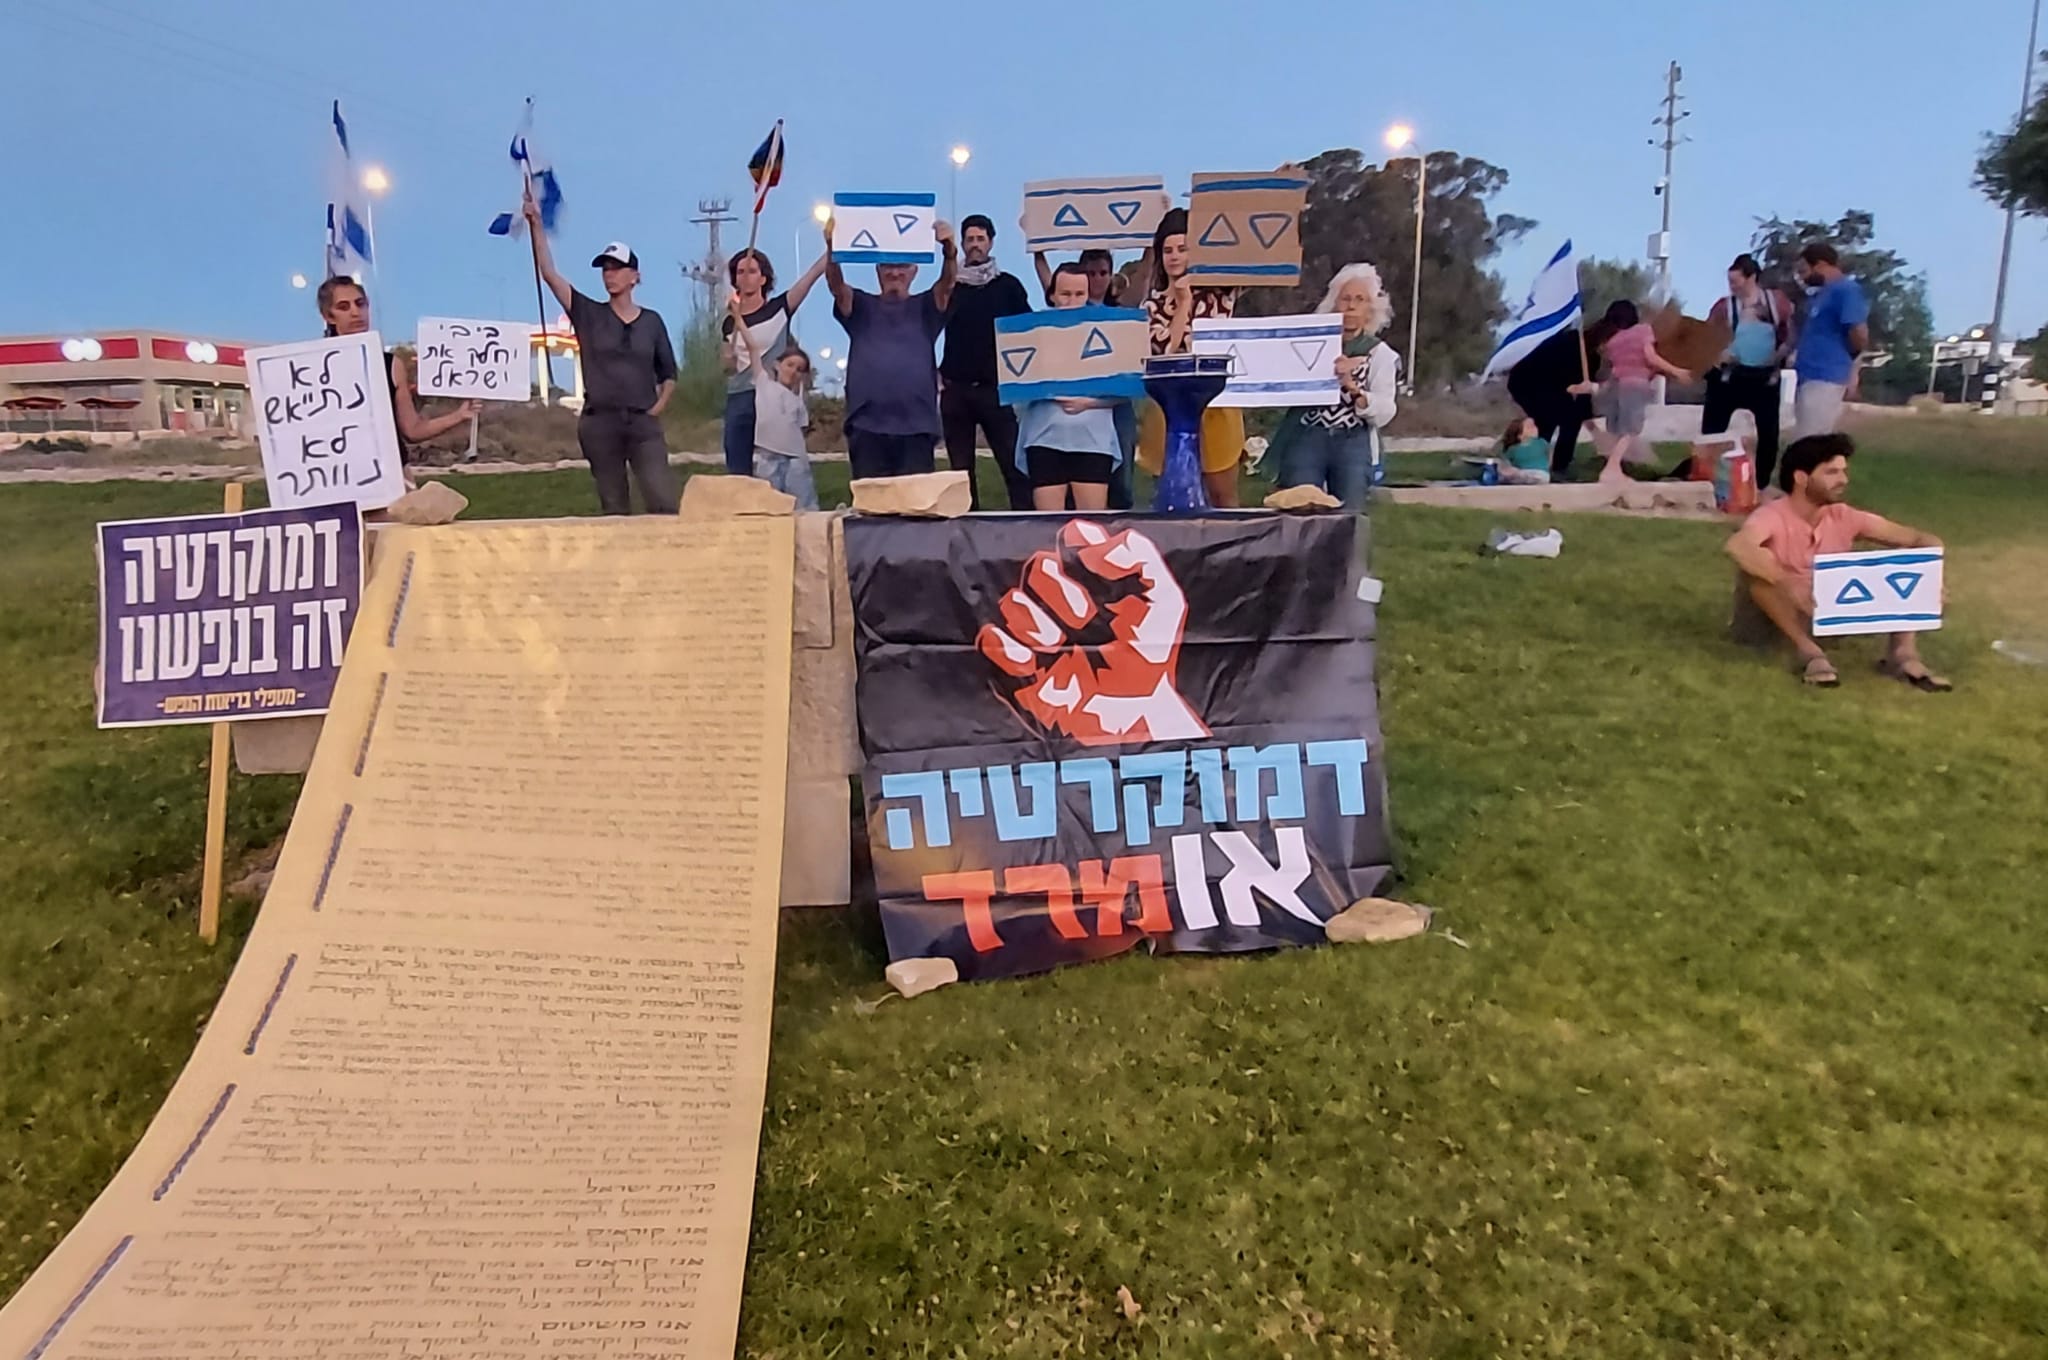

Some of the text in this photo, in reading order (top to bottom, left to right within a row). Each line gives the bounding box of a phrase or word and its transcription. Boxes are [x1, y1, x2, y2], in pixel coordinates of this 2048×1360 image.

[440, 323, 500, 339] ביבי
[289, 350, 341, 389] לא
[422, 344, 455, 361] את
[431, 360, 509, 390] ישראל
[302, 425, 359, 463] לא
[277, 458, 382, 496] נוותר
[123, 518, 342, 605] דמוקרטיה
[119, 598, 347, 683] זה בנפשנו
[882, 738, 1369, 851] דמוקרטיה
[921, 826, 1327, 954] או מרד
